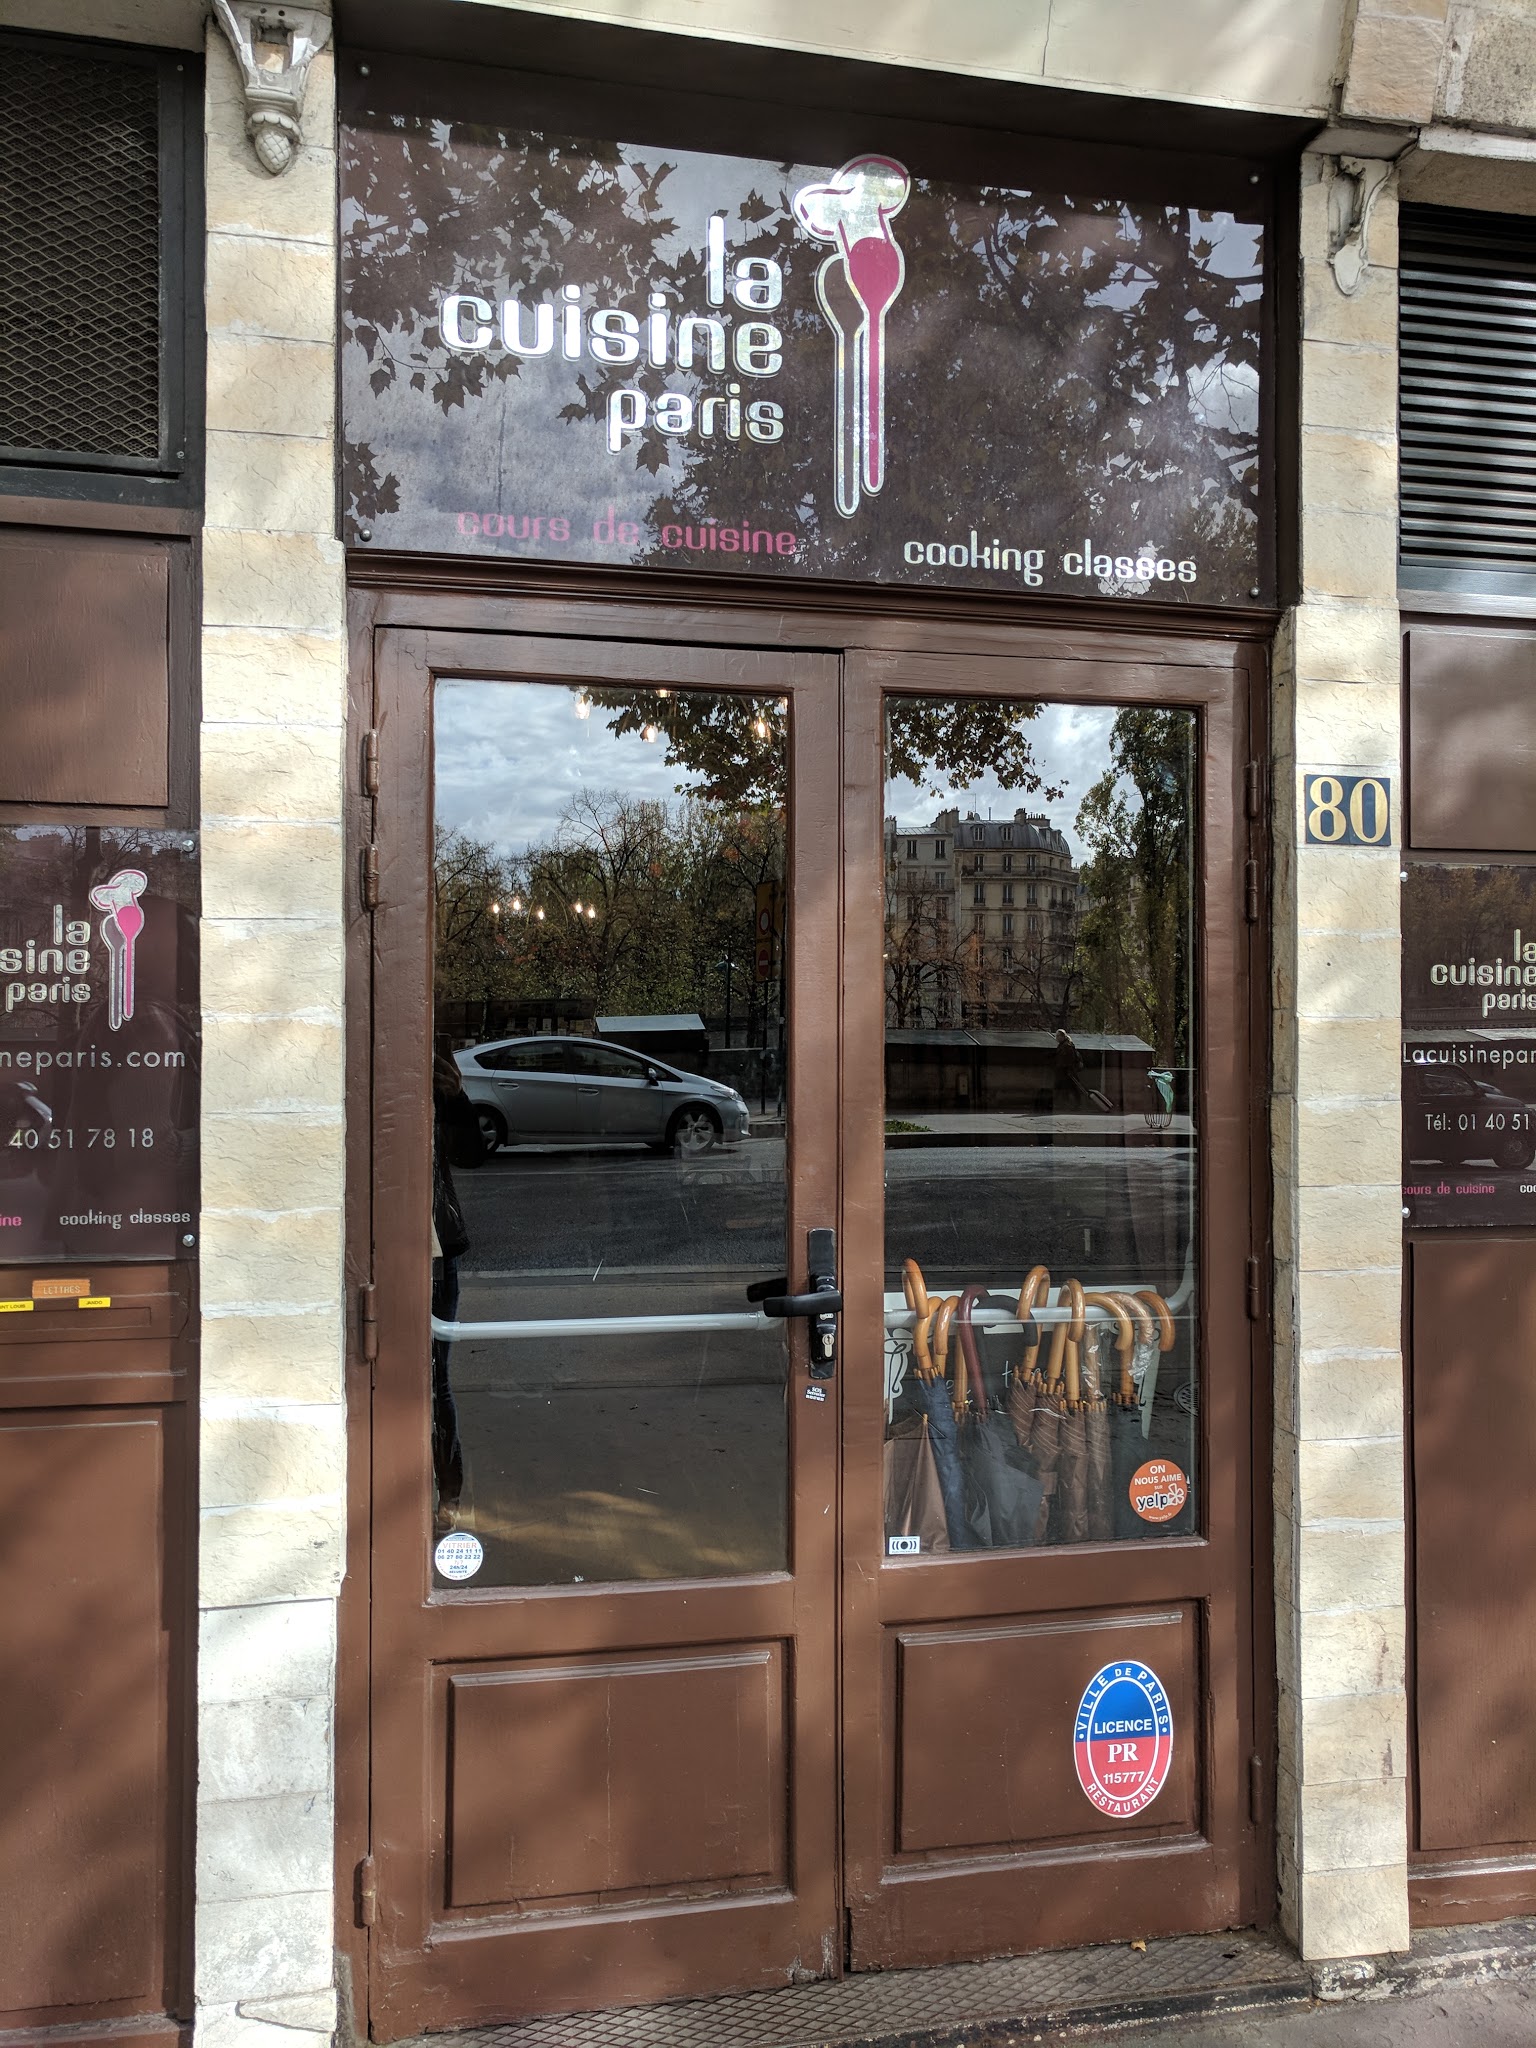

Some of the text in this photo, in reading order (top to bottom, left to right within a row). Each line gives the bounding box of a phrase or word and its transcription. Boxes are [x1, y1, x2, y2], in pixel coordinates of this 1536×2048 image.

[706, 215, 784, 312] la
[439, 284, 784, 378] cuisine
[606, 383, 785, 454] paris
[457, 506, 797, 556] cours de cuisine
[904, 530, 1198, 586] cooking classes
[1308, 776, 1389, 844] 80
[53, 904, 91, 946] la
[6, 976, 92, 1013] paris
[1425, 1112, 1529, 1131] Tél: 01 40 51
[8, 1127, 155, 1149] 40 51 78 18
[1437, 1181, 1451, 1194] de
[1456, 1182, 1495, 1194] cuisine
[59, 1208, 191, 1230] cooking classes
[43, 1285, 81, 1295] LETTRES
[1134, 1473, 1182, 1486] NOUS AIME
[1149, 1464, 1166, 1475] ON
[1136, 1492, 1169, 1512] yelp
[1077, 1667, 1169, 1731] VILLE DE PARIS
[1094, 1718, 1153, 1735] LICENCE
[1107, 1742, 1139, 1763] PR
[1103, 1771, 1145, 1785] 115777
[1086, 1776, 1159, 1813] RESTAURANT
